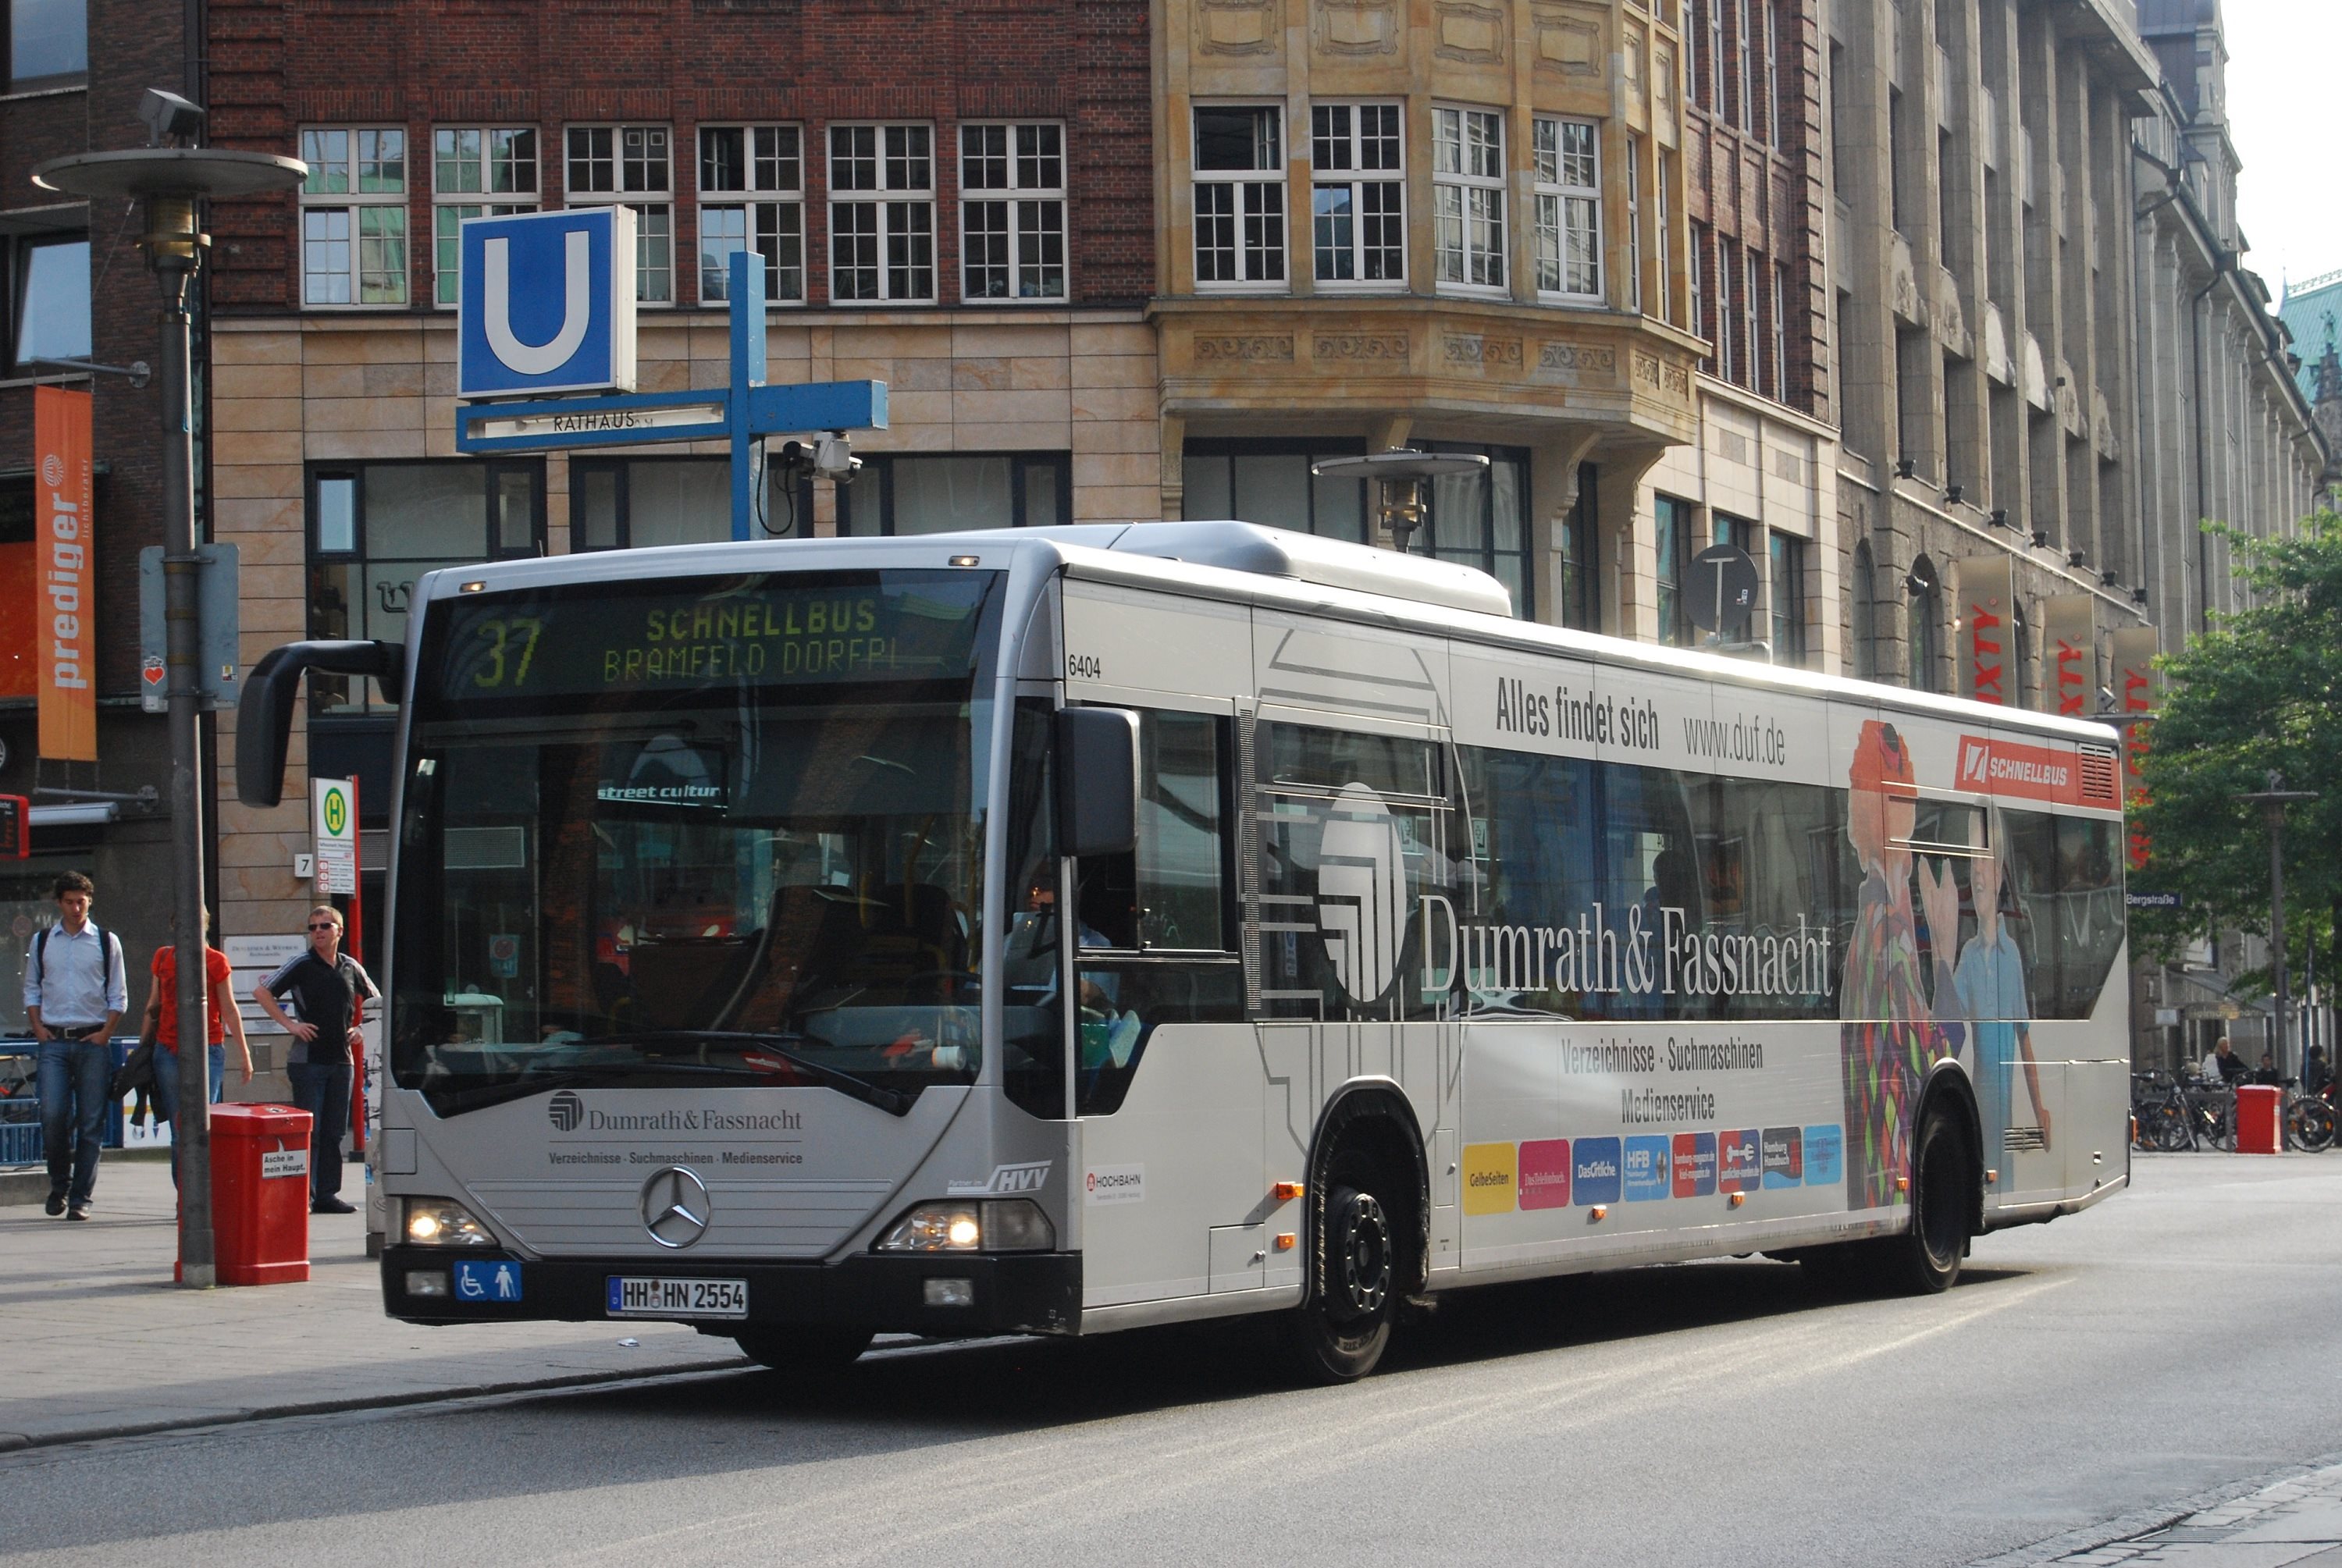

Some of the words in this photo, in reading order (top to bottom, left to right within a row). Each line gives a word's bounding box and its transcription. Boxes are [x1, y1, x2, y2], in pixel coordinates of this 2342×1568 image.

[484, 230, 590, 375] U
[554, 411, 635, 432] RATHAUS
[48, 492, 87, 689] prediger
[646, 599, 876, 642] SCHNELLBUS
[474, 618, 541, 688] 37
[604, 640, 764, 683] BRAMFELD
[1069, 654, 1101, 679] 6404
[1496, 677, 1550, 738] Alles
[1556, 686, 1614, 745] findet
[1621, 697, 1660, 751] sich
[1683, 713, 1785, 766] www.duf.de
[1990, 757, 2067, 787] SCHNELLBUS
[597, 787, 657, 798] street
[660, 784, 730, 798] cultur
[329, 798, 340, 825] H
[301, 859, 309, 872] 7
[2126, 894, 2176, 907] Bergstraße
[1561, 1038, 1654, 1074] Verzeichnisse
[1668, 1036, 1764, 1072] Suchmaschinen
[1621, 1086, 1715, 1124] Medienservice
[265, 1155, 286, 1164] Asche
[549, 1152, 621, 1164] Verzeichnisse
[629, 1151, 714, 1164] Suchmaschinen
[722, 1151, 803, 1164] Medienservice
[1627, 1150, 1650, 1169] HFB
[998, 1167, 1049, 1191] HVV
[1096, 1174, 1141, 1188] HOCHBAHN
[1469, 1171, 1509, 1187] GelbeSeiten
[624, 1282, 648, 1307] HH
[664, 1283, 689, 1308] HN
[695, 1283, 744, 1309] 2554
